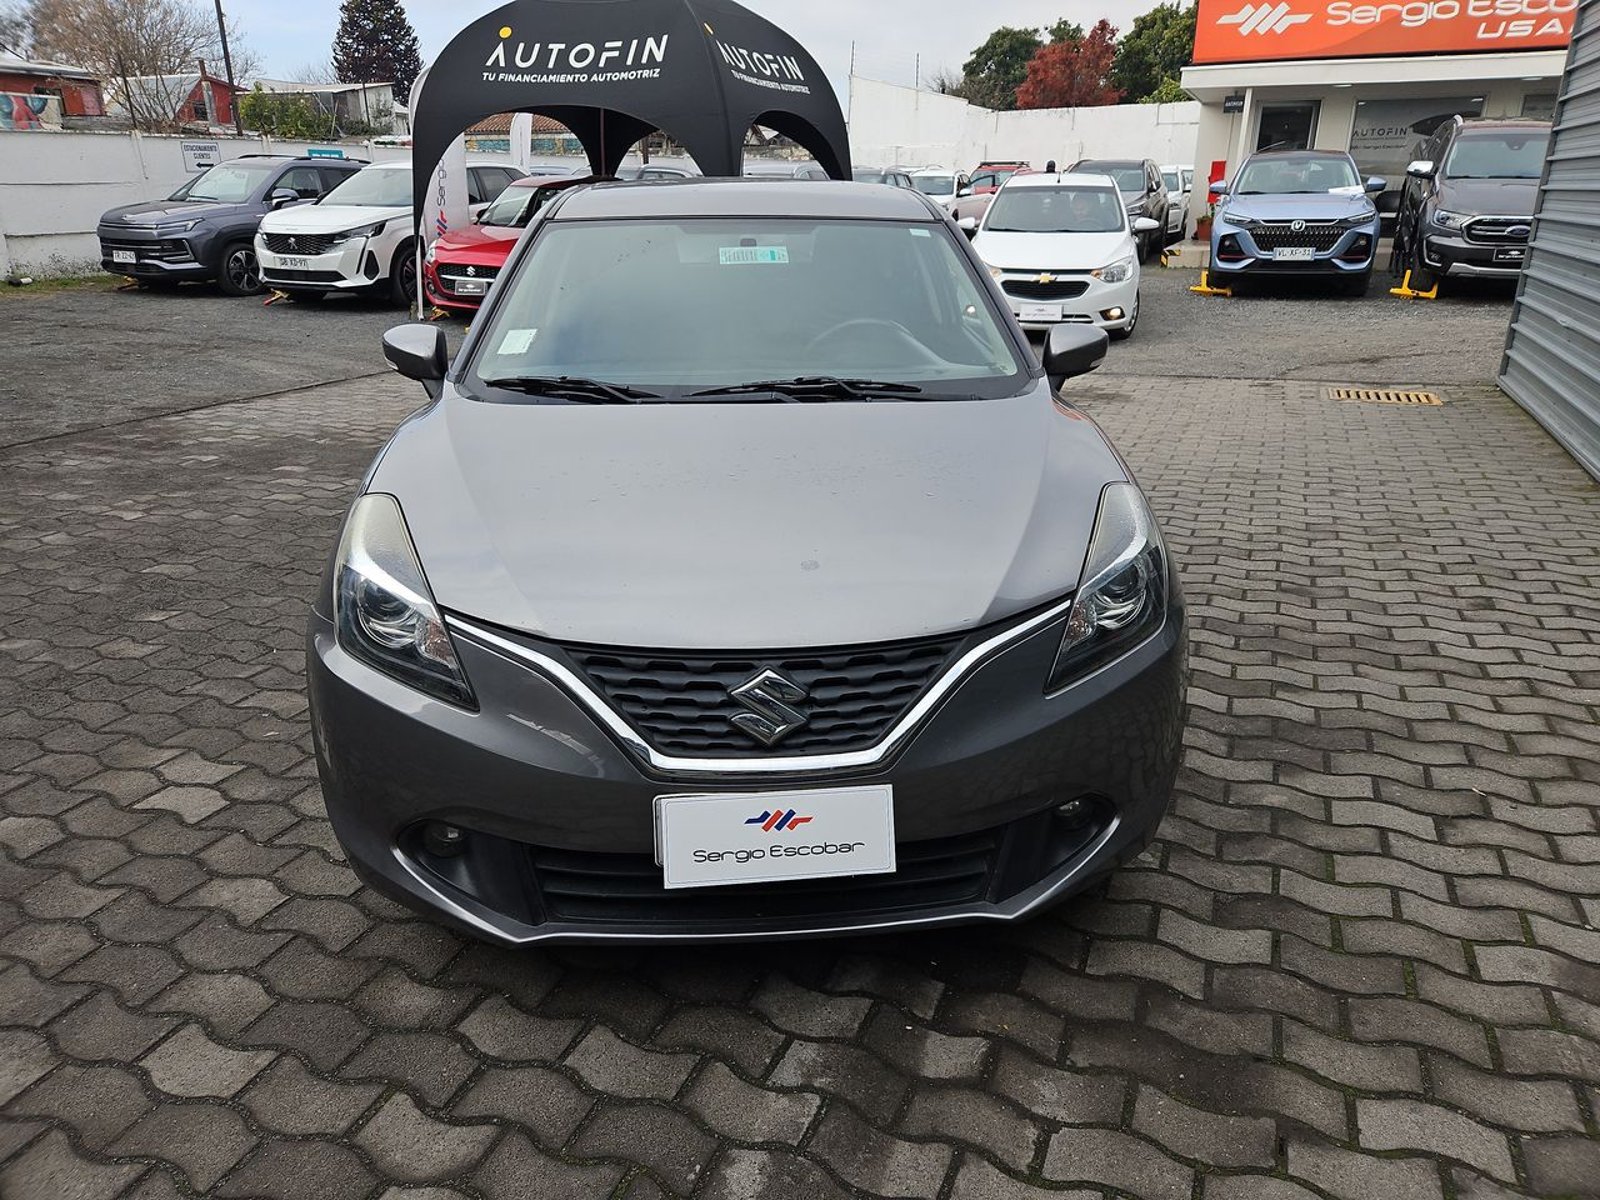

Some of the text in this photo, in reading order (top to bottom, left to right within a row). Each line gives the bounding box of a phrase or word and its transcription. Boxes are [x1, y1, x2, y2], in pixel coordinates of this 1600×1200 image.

[1326, 1, 1460, 27] Sergio
[1476, 17, 1575, 39] USA
[485, 34, 669, 69] AUTOFIN
[715, 39, 805, 81] AUTOFIN
[482, 68, 661, 83] TU FINANCIAMIENTO AUTOMOTRIZ
[1352, 127, 1408, 137] AUTOFIN
[693, 842, 865, 863] Sergio Escobar
